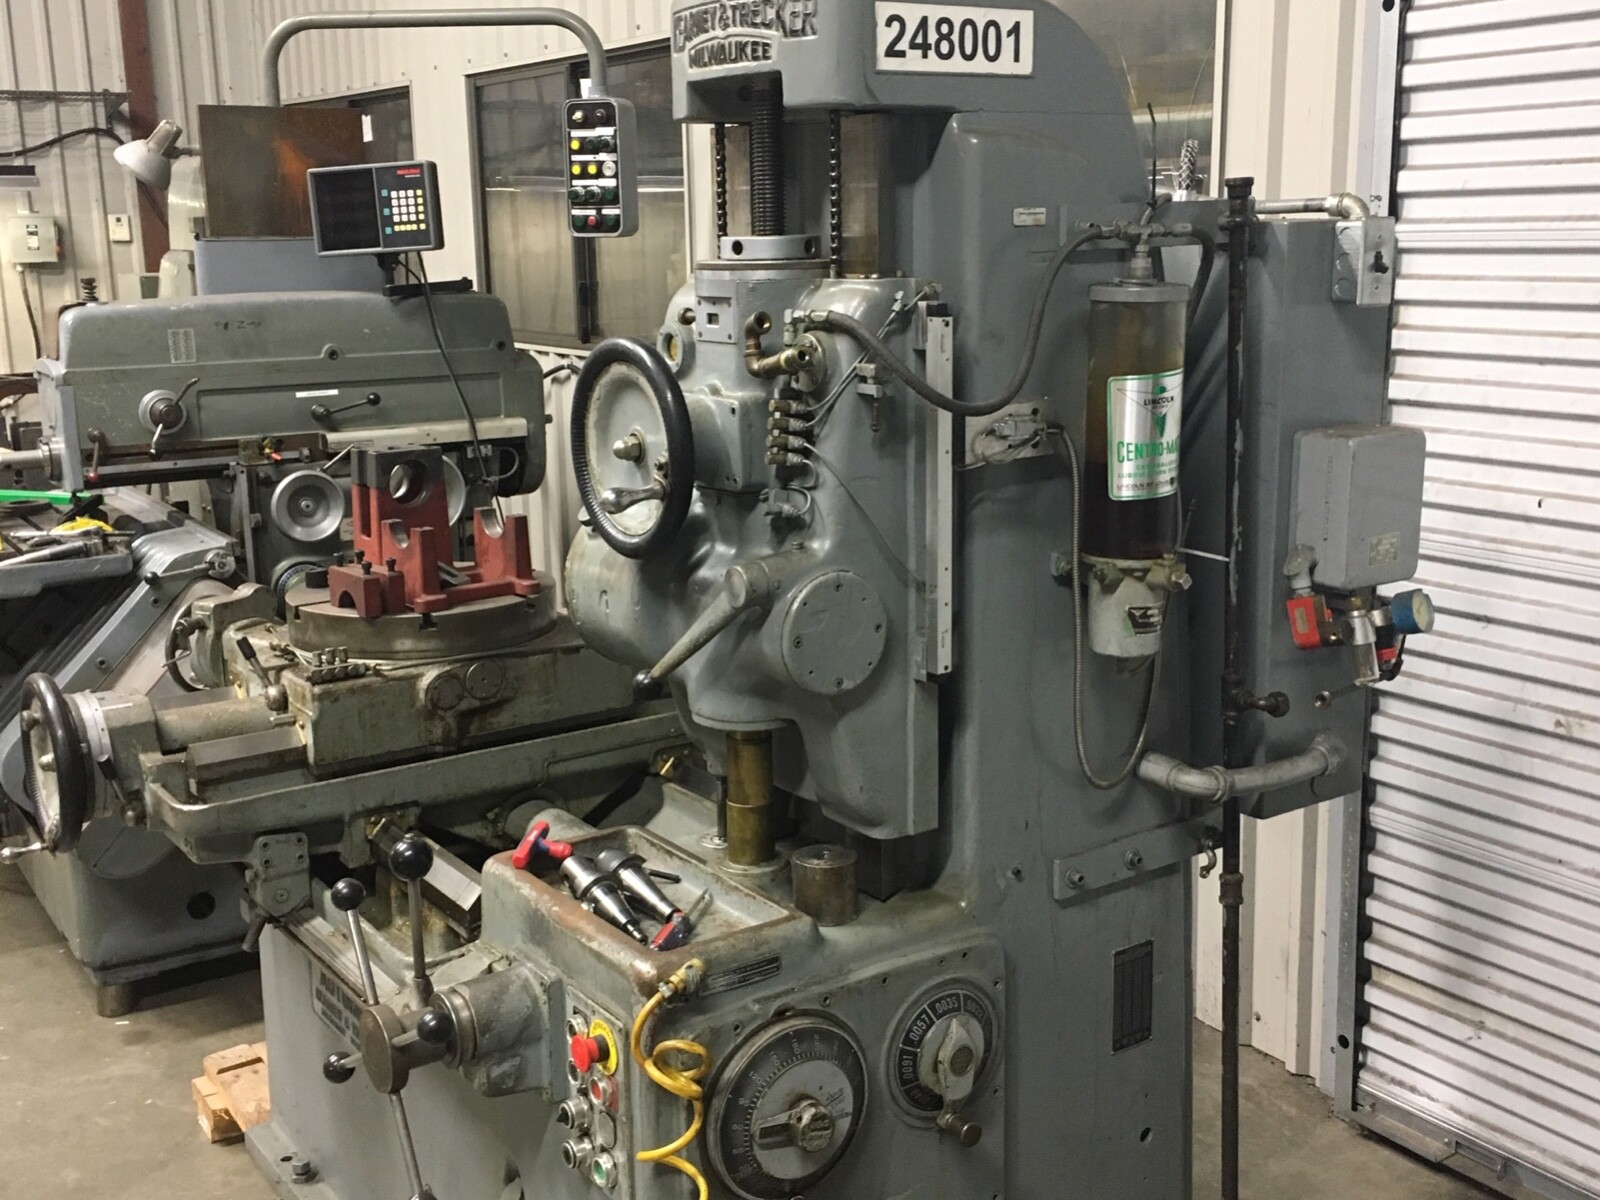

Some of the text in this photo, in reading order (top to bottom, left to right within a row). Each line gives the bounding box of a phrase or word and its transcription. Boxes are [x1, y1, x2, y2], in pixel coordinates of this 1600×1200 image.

[884, 13, 1021, 63] 248001
[689, 40, 771, 69] MILWAUKEE
[1143, 397, 1174, 406] LINCOLN
[935, 997, 959, 1015] .0035
[909, 1014, 930, 1044] .0057
[748, 1071, 763, 1084] 120
[902, 1055, 914, 1079] .0091
